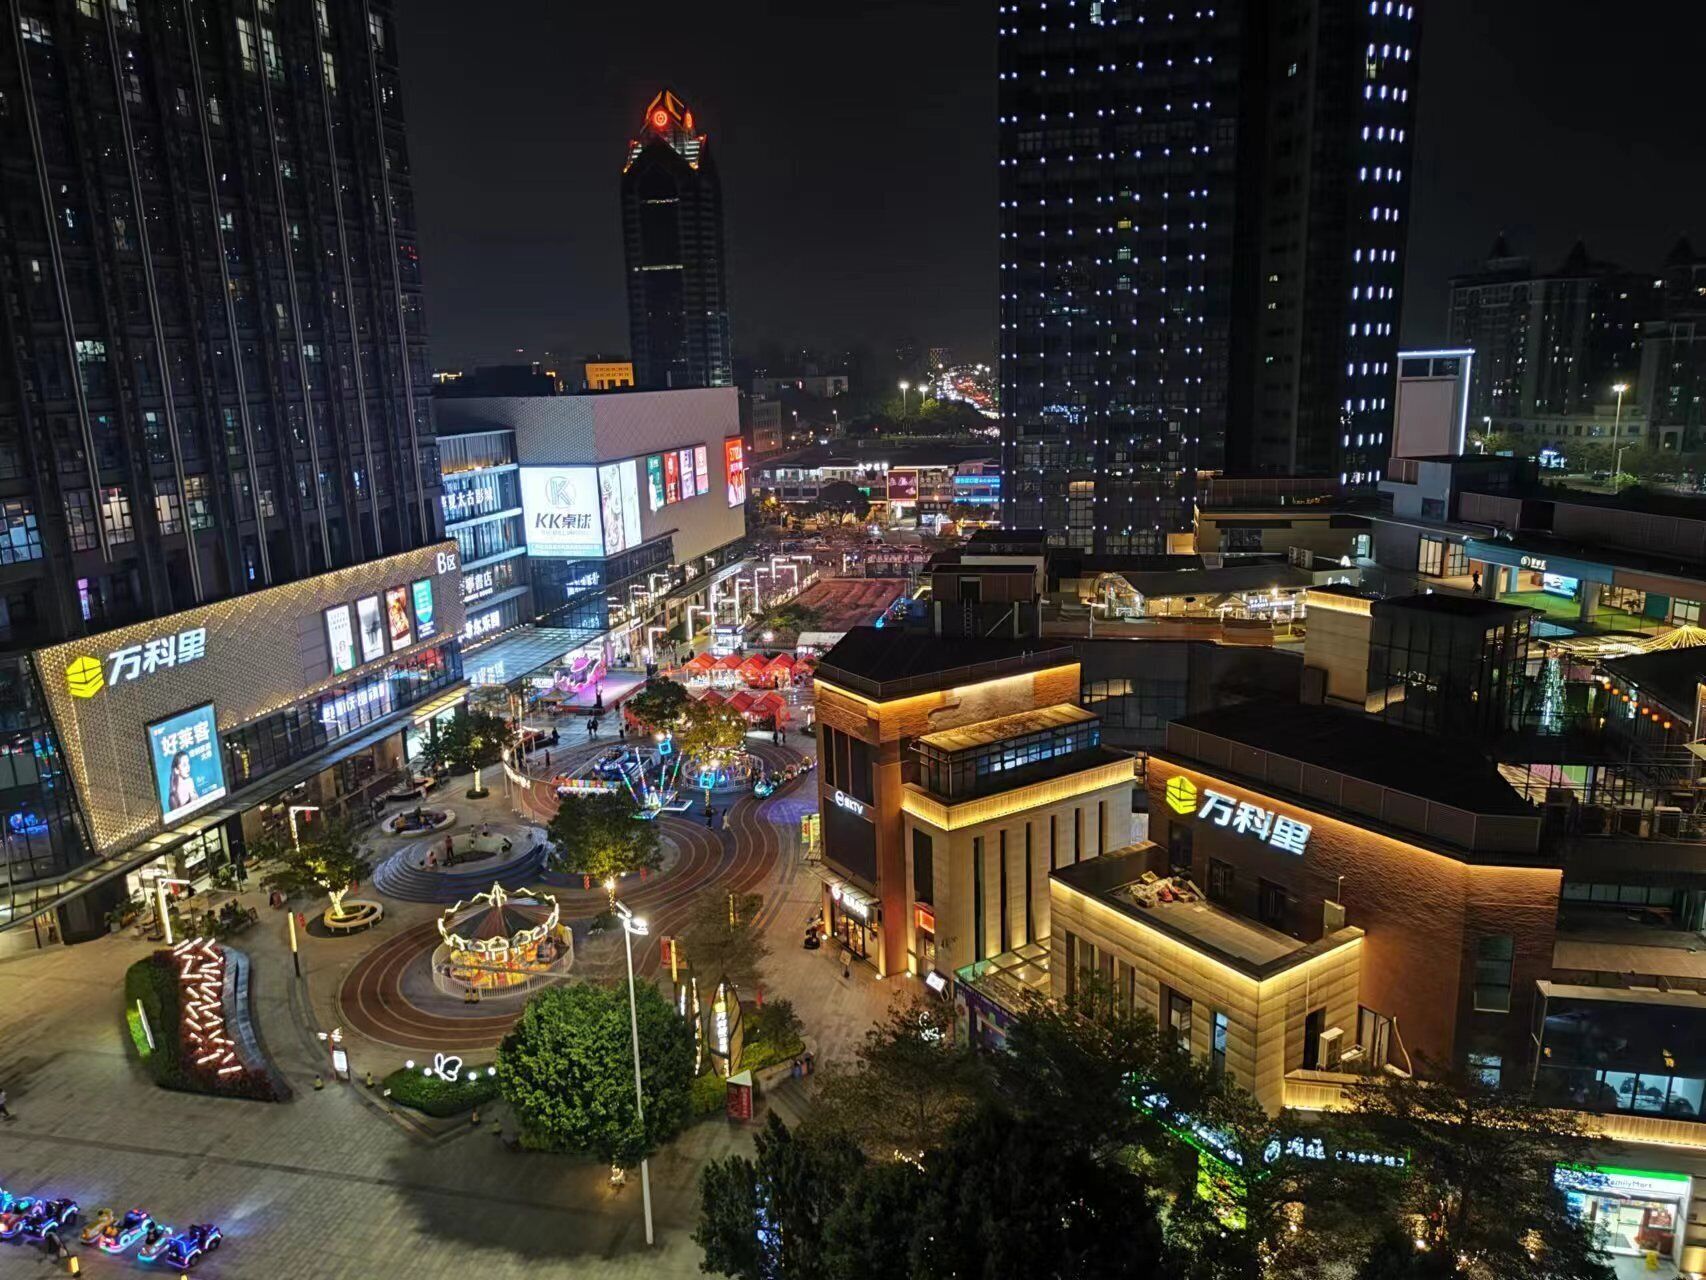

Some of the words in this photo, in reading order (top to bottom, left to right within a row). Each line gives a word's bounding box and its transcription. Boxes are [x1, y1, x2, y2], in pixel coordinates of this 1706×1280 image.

[535, 513, 591, 529] KK桌球
[437, 552, 456, 574] B区
[109, 628, 206, 686] 万科里
[161, 720, 210, 757] 好莱客
[1198, 788, 1312, 855] 万科里
